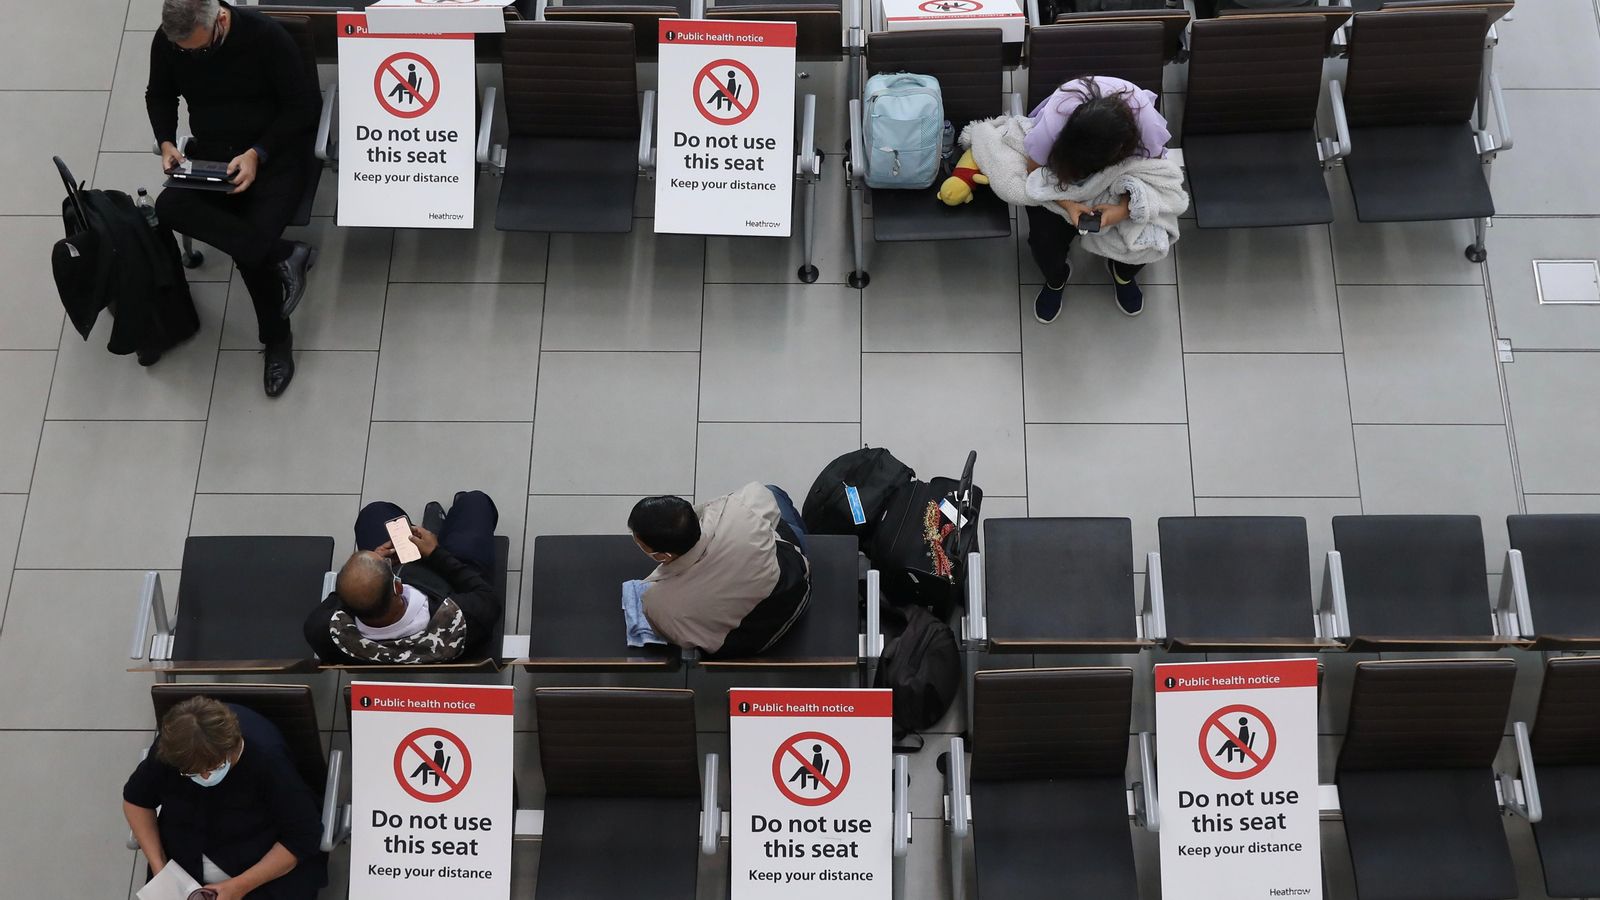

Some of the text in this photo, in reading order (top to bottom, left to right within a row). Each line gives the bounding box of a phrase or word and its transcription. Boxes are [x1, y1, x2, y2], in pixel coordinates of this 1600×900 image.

[677, 32, 764, 43] Public health notice
[357, 126, 458, 142] Do not use
[674, 132, 776, 150] Do not use
[367, 147, 446, 163] this seat
[684, 153, 764, 171] this seat
[354, 172, 458, 184] Keep your distance
[671, 179, 776, 192] Keep your distance
[428, 213, 464, 221] Heathrow
[745, 220, 781, 228] Heathrow
[1178, 675, 1281, 687] Public health notice
[373, 698, 476, 710] Public health notice
[752, 704, 855, 713] Public health notice
[1179, 790, 1298, 808] Do not use
[372, 810, 492, 831] Do not use
[752, 815, 871, 833] Do not use
[1192, 813, 1286, 832] this seat
[384, 835, 478, 856] this seat
[764, 839, 858, 858] this seat
[1178, 842, 1302, 858] Keep your distance
[369, 865, 492, 880] Keep your distance
[750, 869, 873, 883] Keep your distance
[1269, 888, 1311, 897] Heathrow
